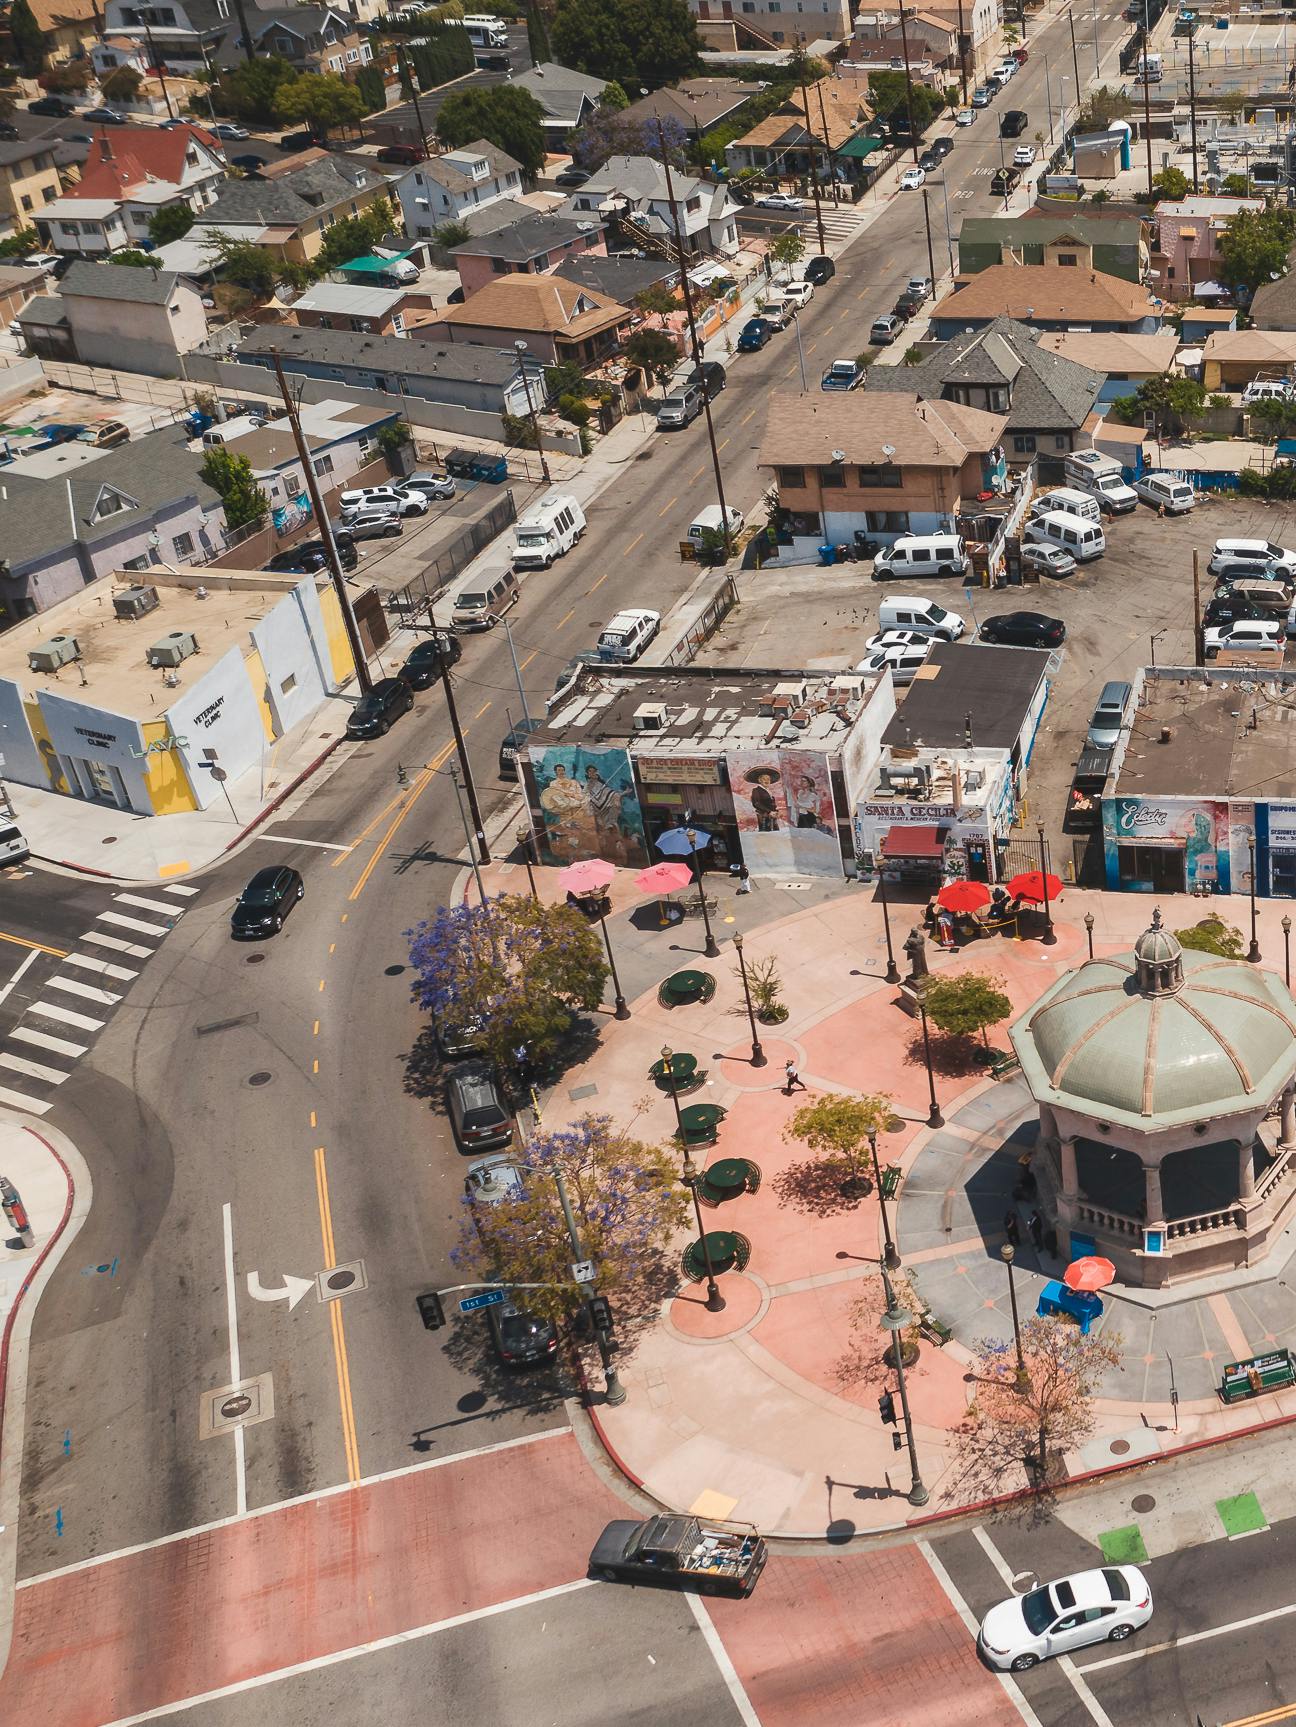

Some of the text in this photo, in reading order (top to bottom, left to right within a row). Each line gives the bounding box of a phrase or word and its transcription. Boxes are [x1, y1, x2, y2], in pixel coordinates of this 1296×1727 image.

[972, 167, 996, 176] XING
[953, 190, 974, 199] PED
[193, 696, 225, 726] VETERINARY
[204, 710, 222, 729] CLINIC
[75, 728, 116, 743] VETERINARY
[87, 738, 111, 749] CLINIC
[864, 805, 957, 818] SANTA CECILIA
[1120, 801, 1168, 829] Eclectic
[466, 1294, 499, 1308] 1st St
